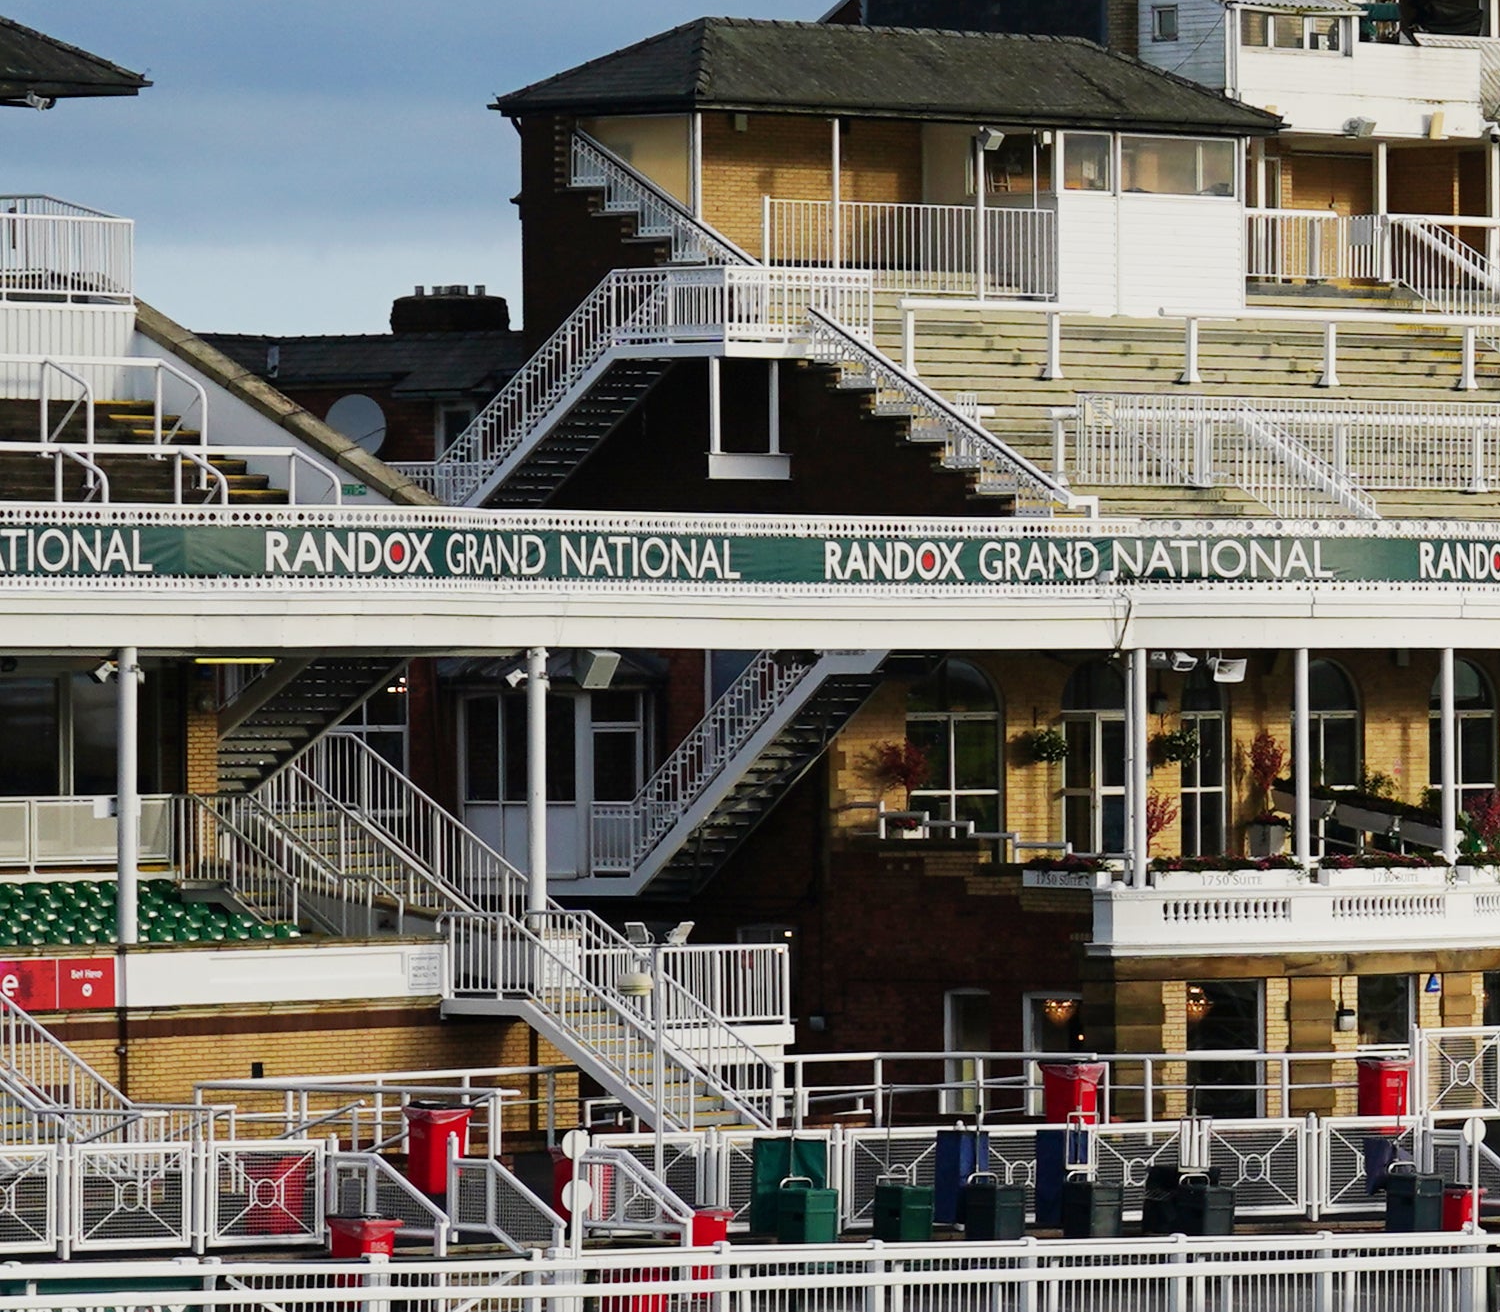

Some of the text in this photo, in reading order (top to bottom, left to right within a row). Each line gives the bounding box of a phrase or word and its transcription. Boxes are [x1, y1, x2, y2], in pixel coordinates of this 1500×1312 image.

[0, 529, 153, 572] TIONAL
[265, 530, 740, 580] RANDOX GRAND NATIONAL
[824, 539, 1335, 581] RANDOX GRAND NATIONAL
[1201, 874, 1230, 886] 1750
[71, 968, 103, 979] Bet Here
